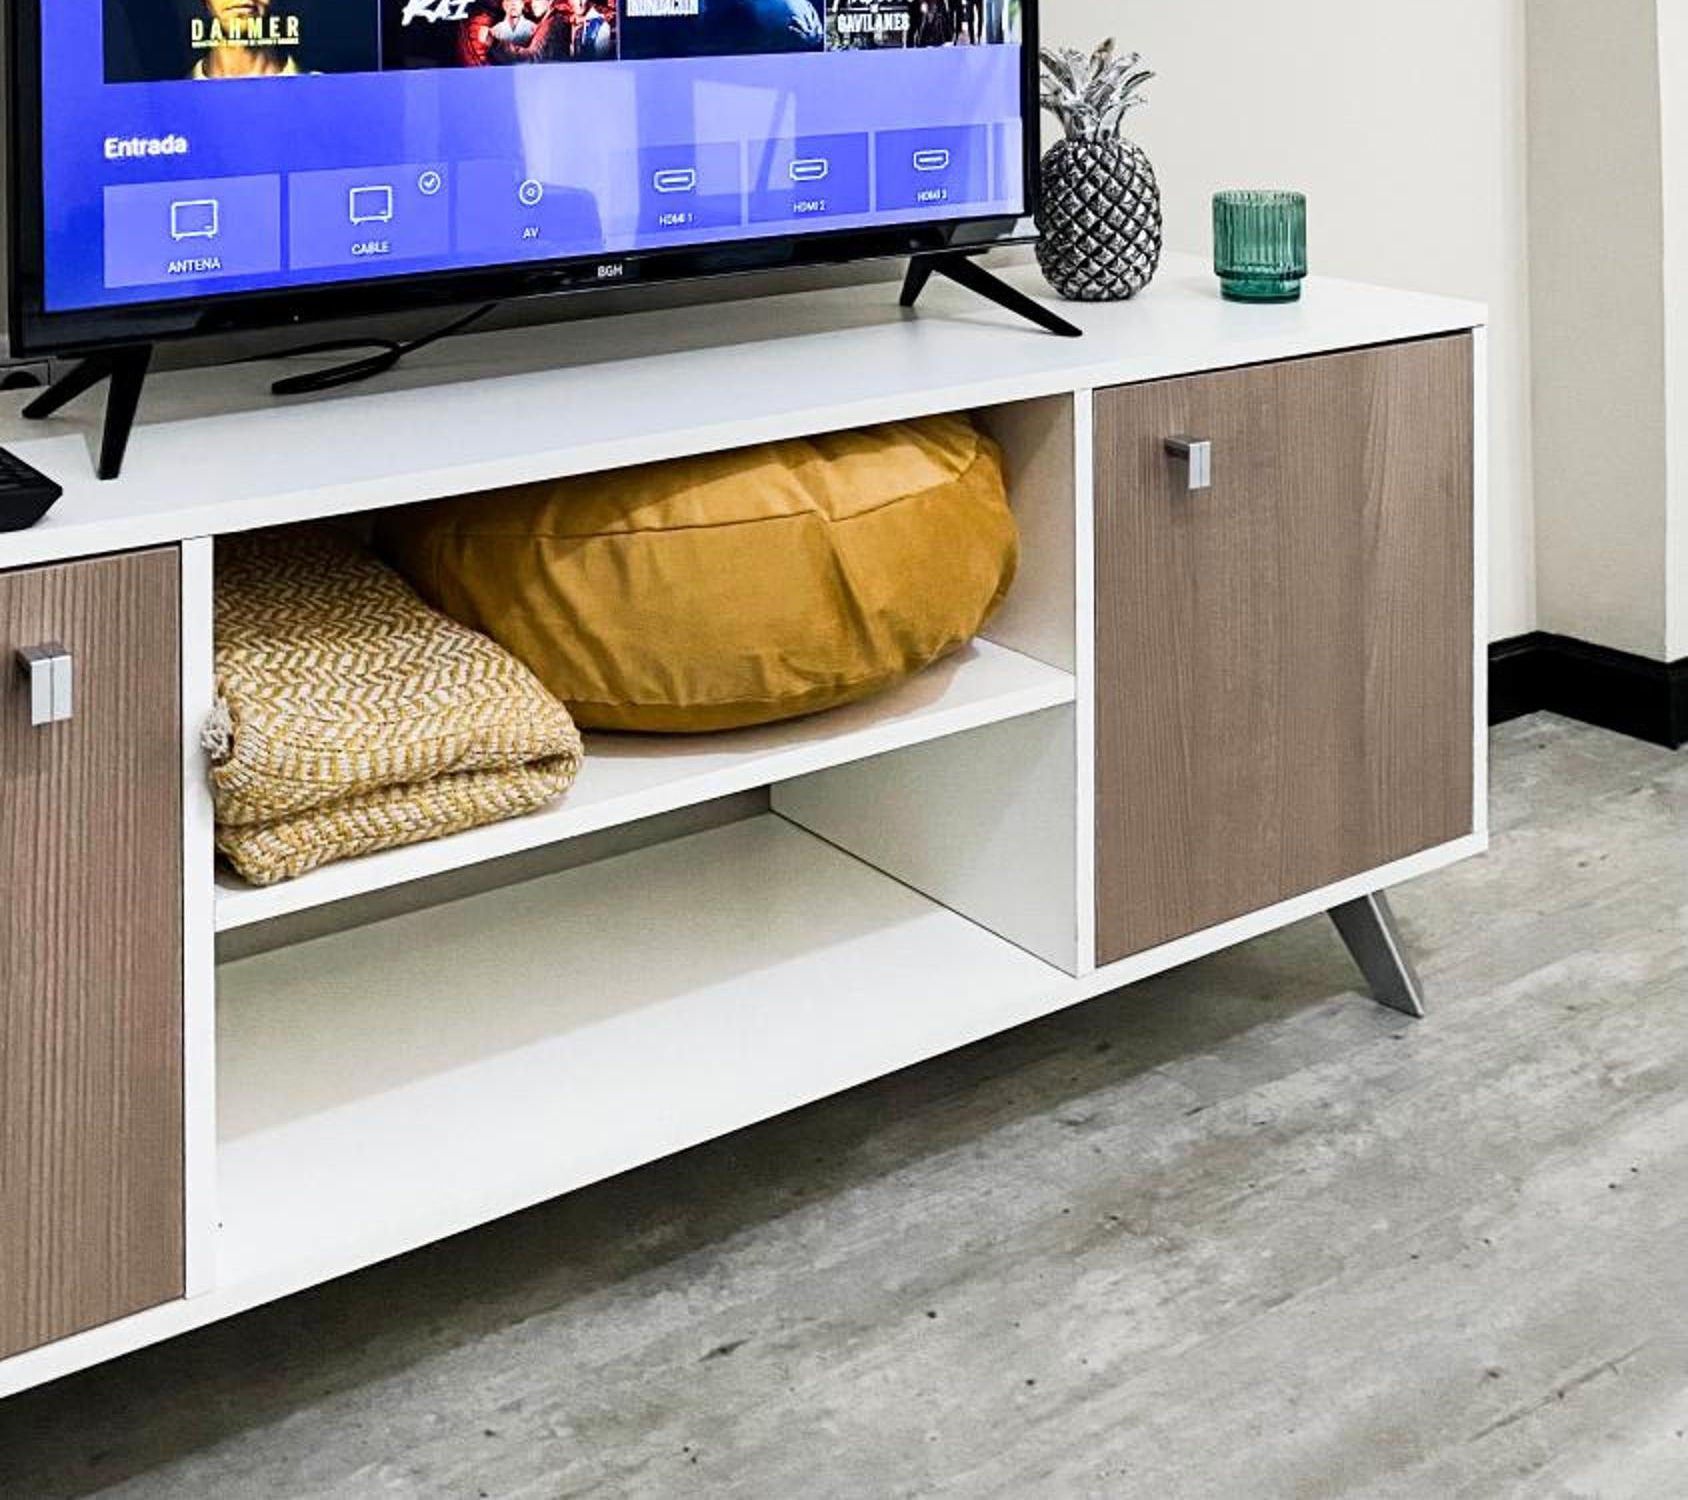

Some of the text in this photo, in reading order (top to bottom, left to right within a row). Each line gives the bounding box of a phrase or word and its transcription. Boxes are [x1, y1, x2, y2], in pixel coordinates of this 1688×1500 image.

[191, 15, 299, 40] DAHMER
[104, 135, 188, 159] Entrada
[523, 228, 540, 239] AV
[351, 241, 391, 256] CABLE
[168, 258, 221, 274] ANTENA
